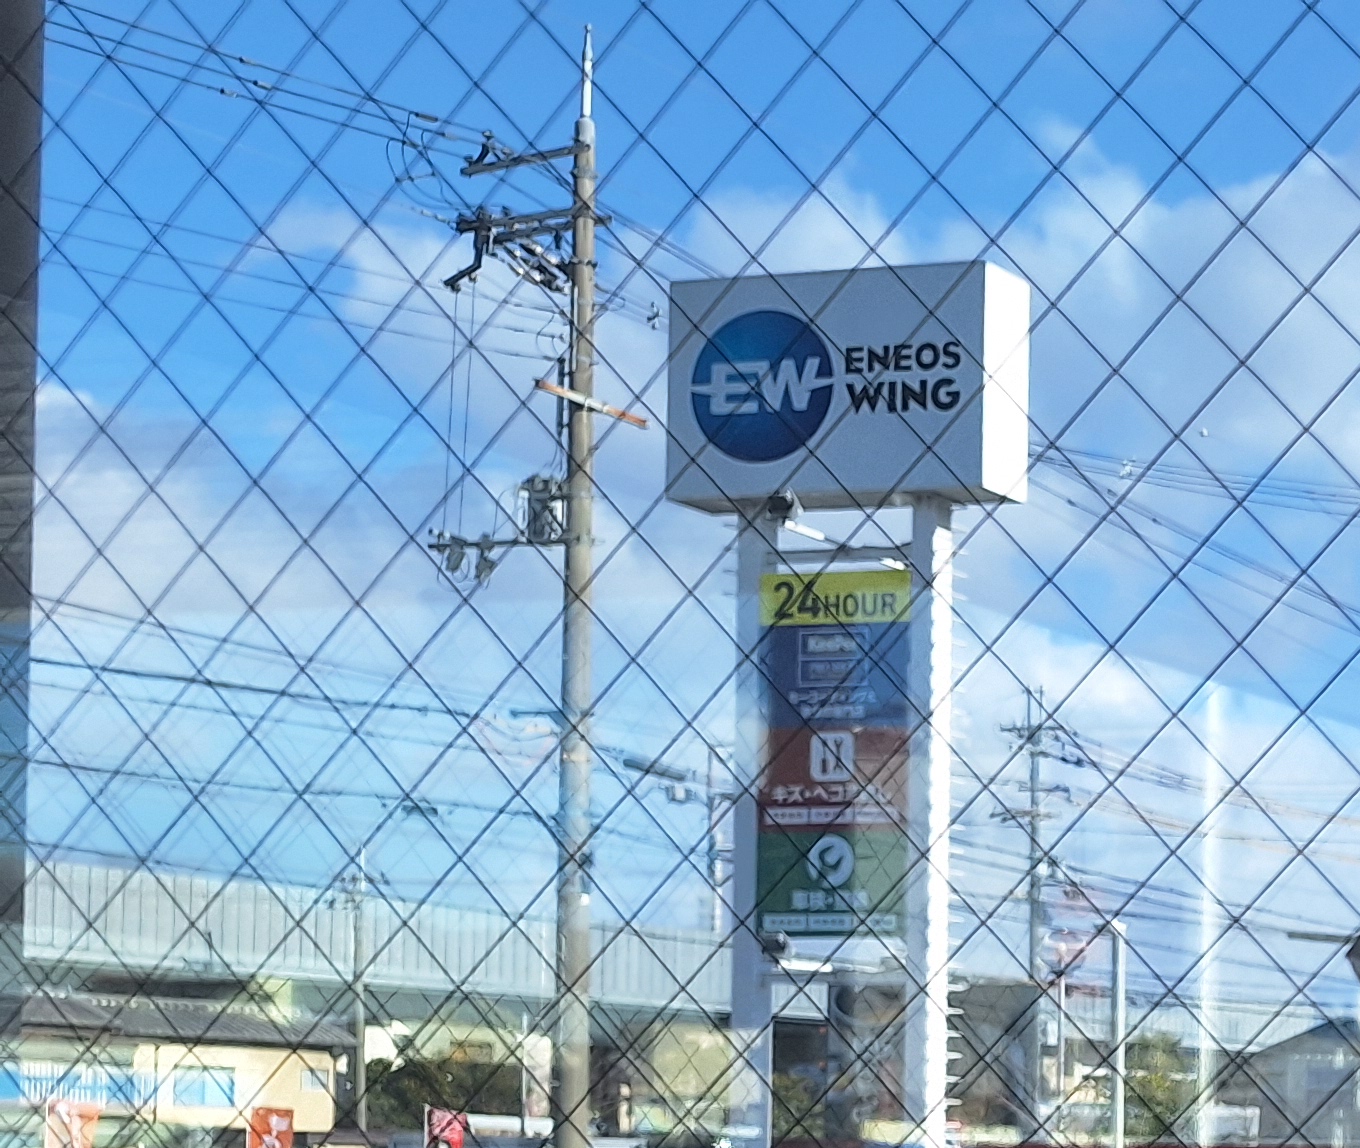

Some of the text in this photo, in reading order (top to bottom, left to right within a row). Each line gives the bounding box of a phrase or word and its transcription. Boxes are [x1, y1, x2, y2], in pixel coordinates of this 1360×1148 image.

[844, 341, 961, 375] ENEOS
[698, 356, 828, 416] EW
[846, 377, 961, 414] WING
